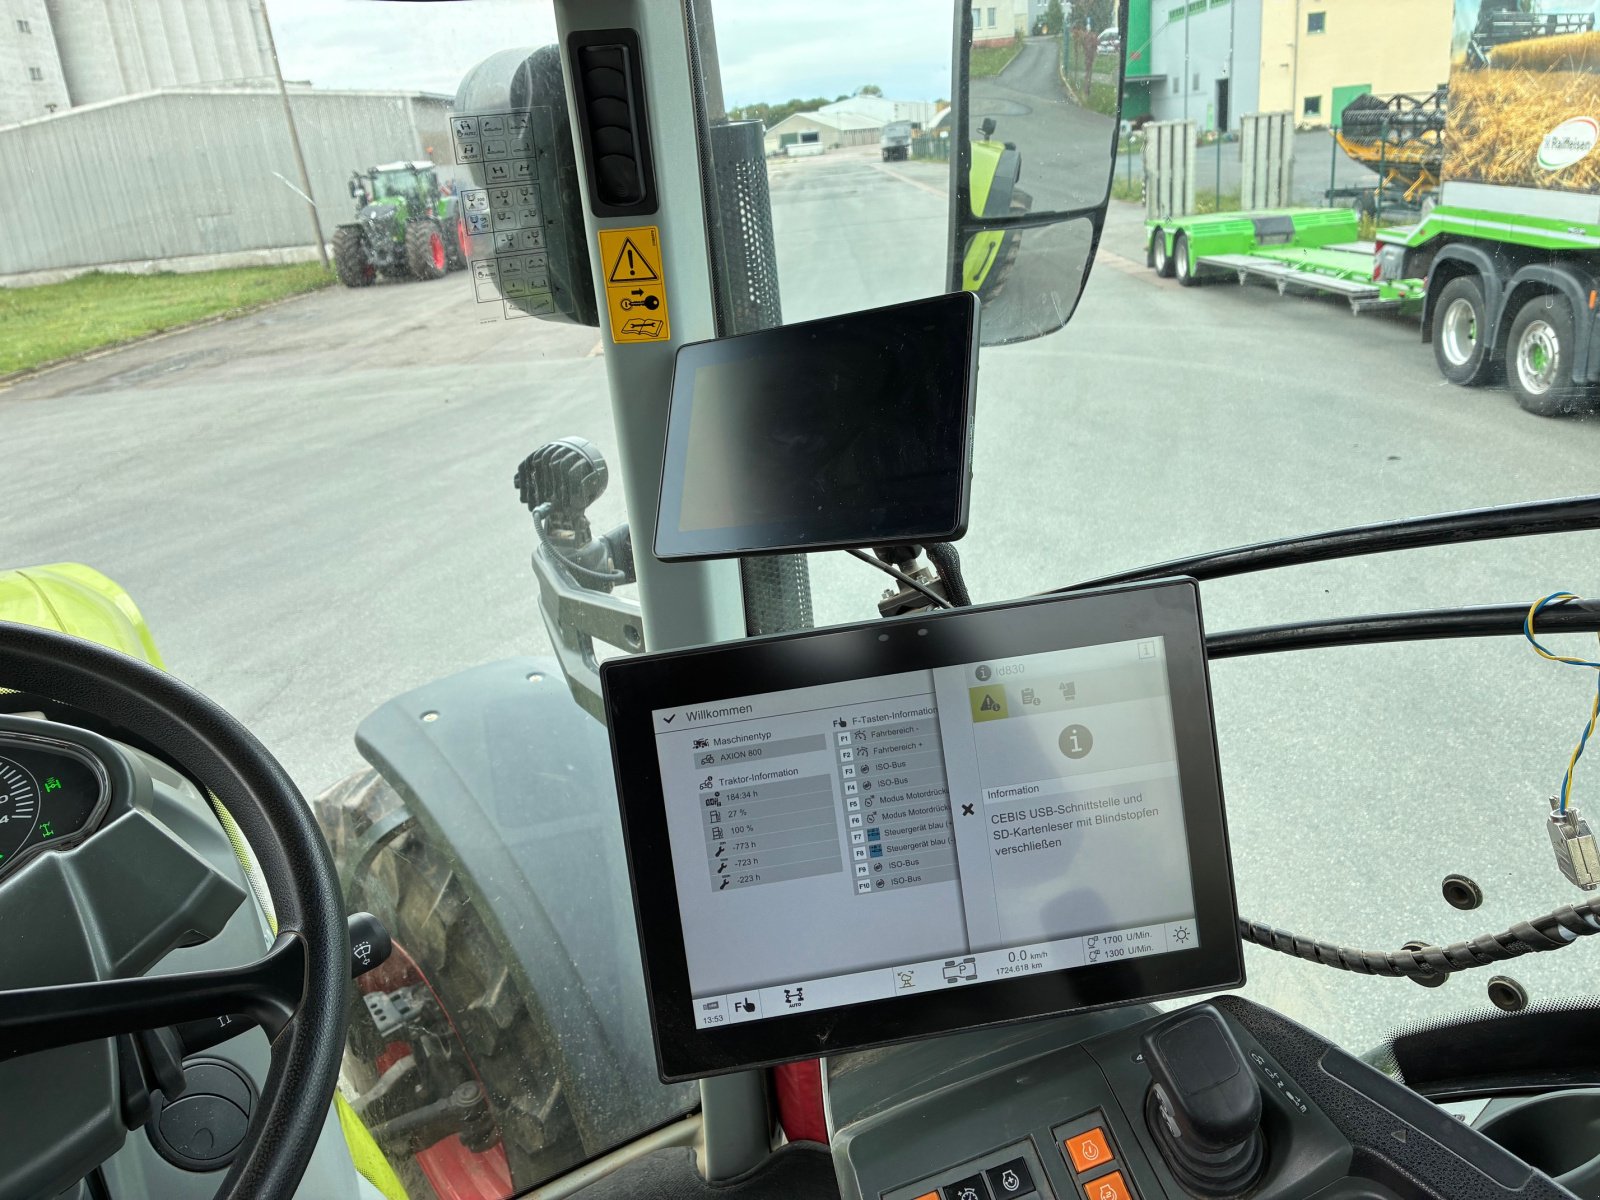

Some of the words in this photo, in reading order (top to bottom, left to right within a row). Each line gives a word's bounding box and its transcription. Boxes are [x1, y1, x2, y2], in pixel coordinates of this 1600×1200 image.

[686, 704, 753, 721] Willkommen
[852, 707, 938, 725] F-Tasten-Information
[871, 726, 914, 738] Fahrbereich
[713, 731, 772, 746] Maschinentyp
[873, 743, 916, 754] Fahrbereich
[720, 751, 746, 762] AXION
[748, 748, 762, 757] 800
[875, 761, 906, 771] ISO-Bus
[719, 767, 799, 786] Traktor-Information
[877, 777, 908, 787] ISO-Bus
[726, 792, 751, 801] 184:34
[987, 784, 1040, 799] Information
[880, 795, 904, 804] Modus
[728, 810, 737, 818] 27
[991, 810, 1027, 825] CEBIS
[1029, 796, 1120, 819] USB-Schnittstelle
[1123, 793, 1143, 804] und
[882, 811, 906, 820] Modus
[731, 825, 744, 834] 100
[746, 824, 754, 832] %
[884, 824, 927, 836] Steuergerät
[928, 822, 944, 830] blau
[993, 820, 1073, 840] SD-Kartenleser
[1076, 817, 1093, 828] mit
[1095, 807, 1159, 825] Blindstopfen
[733, 842, 749, 850] -773
[886, 840, 929, 852] Steuergerät
[931, 838, 946, 846] blau
[995, 838, 1062, 856] verschließen
[735, 858, 752, 867] -723
[888, 859, 919, 869] ISO-Bus
[737, 875, 754, 883] -223
[891, 875, 922, 885] ISO-Bus
[1103, 934, 1123, 944] 1700
[1126, 930, 1152, 942] U/Min.
[1008, 950, 1027, 963] 0.0
[1030, 951, 1048, 960] km/h
[1104, 948, 1124, 958] 1300
[1128, 944, 1154, 955] U/Min.
[996, 964, 1029, 975] 1724.618
[1031, 961, 1043, 969] km
[703, 1015, 723, 1024] 13:53
